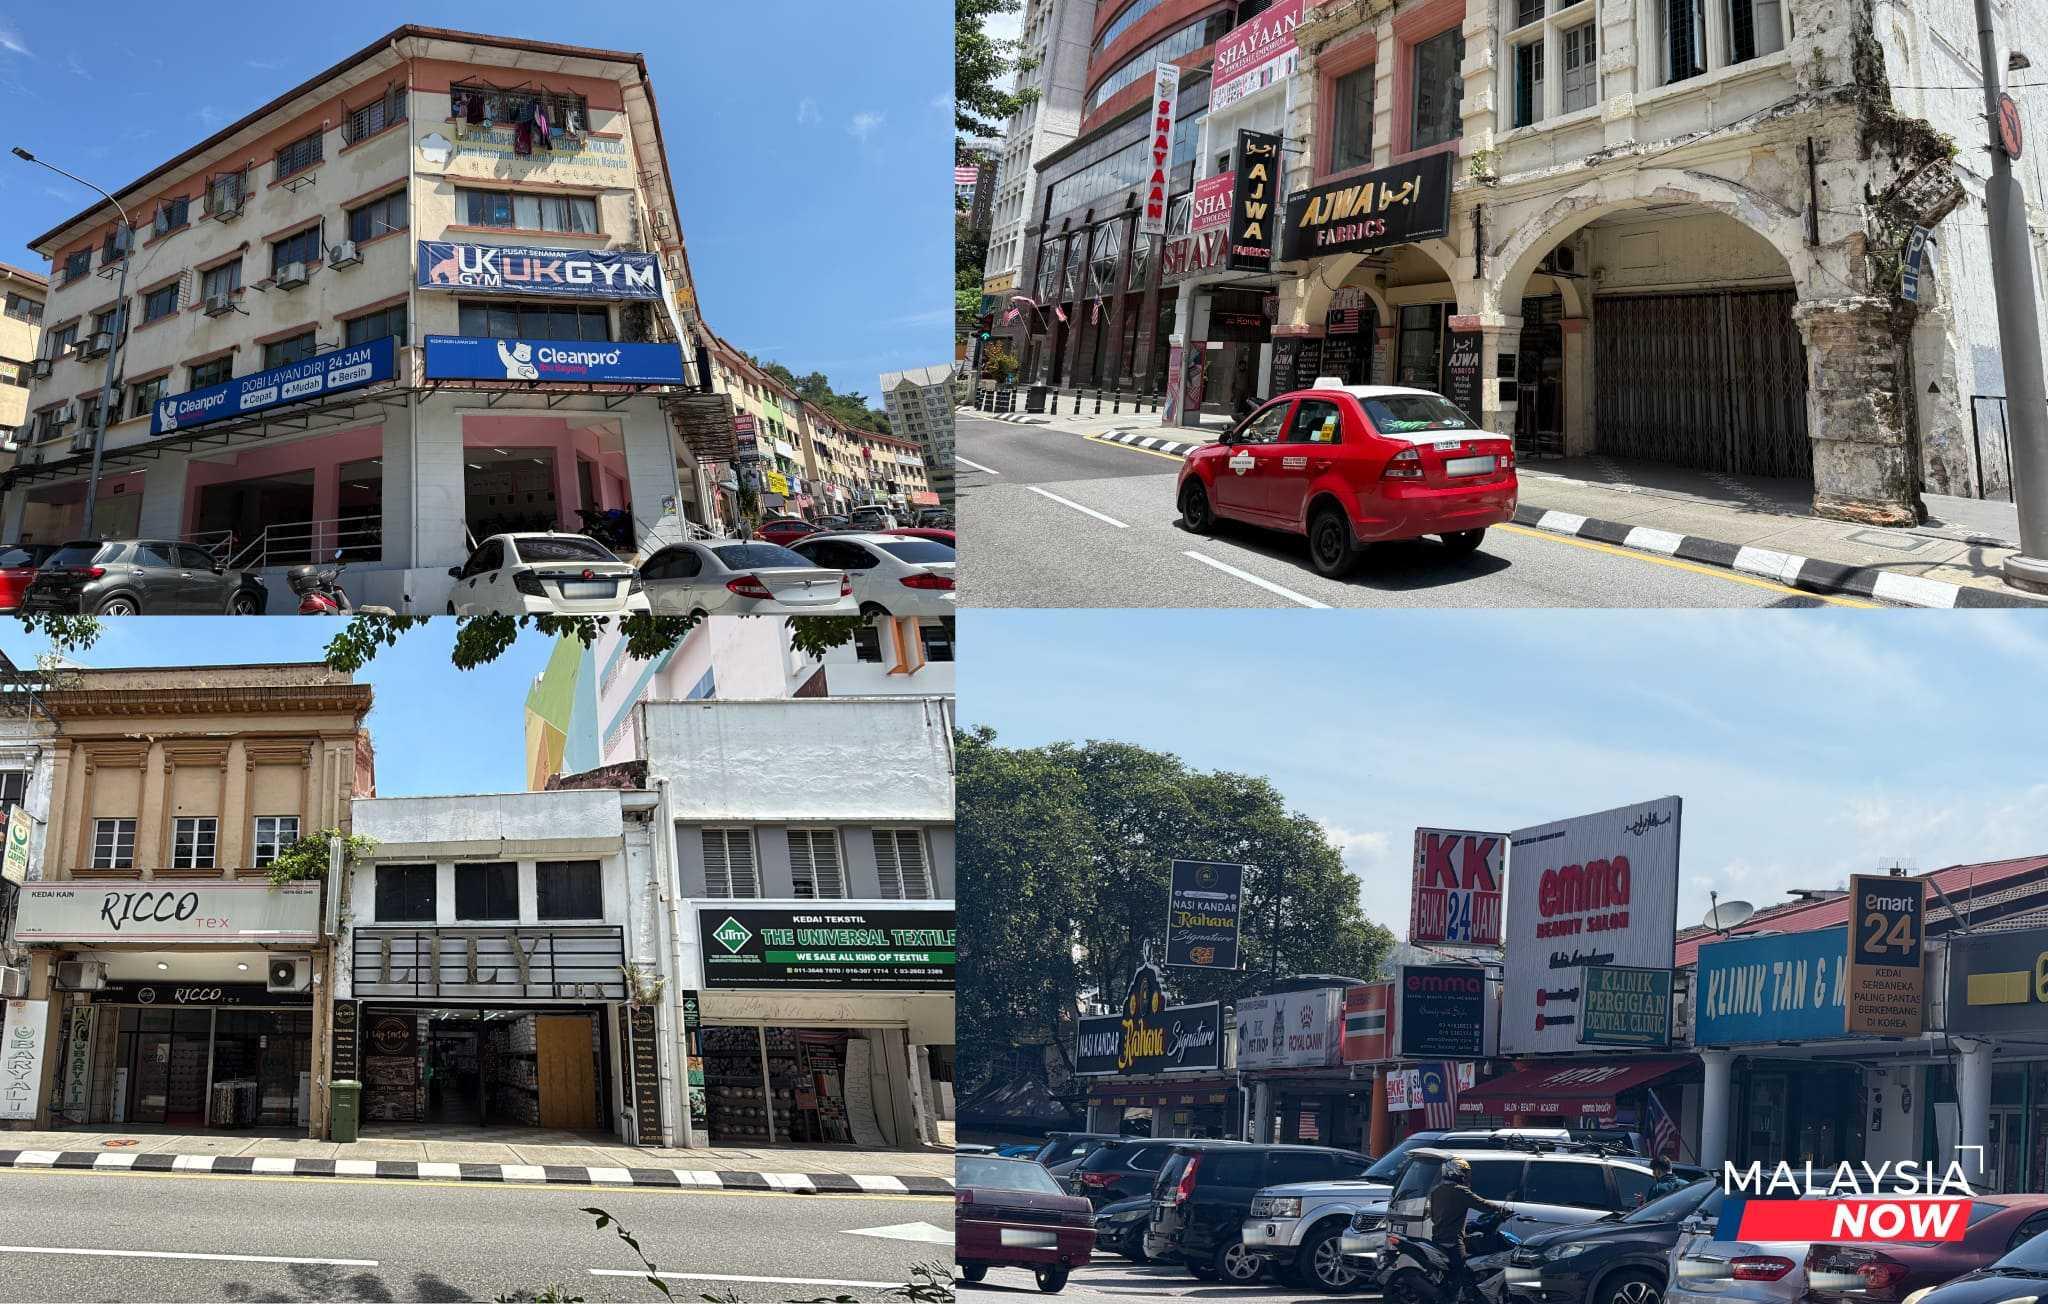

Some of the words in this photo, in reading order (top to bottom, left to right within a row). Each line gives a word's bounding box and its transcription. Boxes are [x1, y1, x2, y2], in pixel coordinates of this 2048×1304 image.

[1218, 8, 1298, 70] SHAYAAN
[1147, 100, 1170, 219] SHAYAAN
[1194, 190, 1234, 218] SHAY
[1243, 163, 1268, 240] AJWA
[1298, 182, 1374, 228] AJWA
[1202, 210, 1230, 224] WHOLESAL
[1316, 218, 1386, 247] FABRICS
[458, 246, 499, 274] UK
[502, 248, 528, 256] PUSAT
[529, 249, 567, 258] SENAMAN
[1232, 245, 1271, 258] FABRICS
[459, 273, 500, 287] GYM
[538, 347, 618, 367] Cleanpro
[1448, 352, 1479, 367] AJWA
[242, 376, 266, 392] DOBI
[268, 367, 301, 386] LAYAN
[303, 360, 325, 377] DIRI
[329, 357, 342, 370] 24
[345, 349, 371, 366] JAM
[338, 368, 367, 382] Bersih
[291, 379, 320, 393] Mudah
[179, 393, 225, 414] Cleanpro
[1425, 833, 1499, 891] KK
[32, 890, 55, 898] KEDAI
[56, 890, 75, 898] KAIN
[1538, 855, 1631, 918] emma
[100, 891, 199, 931] RICCO
[1173, 900, 1195, 910] NASI
[1197, 901, 1237, 913] KANDAR
[1865, 893, 1915, 913] emart
[793, 915, 823, 924] KEDAI
[824, 915, 866, 924] TEKSTIL
[1420, 893, 1446, 937] BUKA
[1447, 891, 1472, 941] 24
[1473, 896, 1500, 940] JAM
[1536, 918, 1582, 939] BEAUTY
[1586, 911, 1630, 933] SALON
[760, 928, 795, 946] THE
[797, 928, 890, 947] UNIVERSAL
[1863, 912, 1917, 956] 24
[375, 935, 545, 985] LILY
[796, 952, 812, 961] WE
[814, 952, 837, 961] SALE
[838, 952, 855, 961] ALL
[856, 953, 877, 961] KIND
[878, 953, 892, 962] OF
[894, 953, 930, 962] TEXTILE
[1600, 970, 1654, 993] KLINIK
[1875, 967, 1902, 978] KEDAI
[1407, 975, 1481, 993] emma
[1706, 964, 1767, 1021] KLINIK
[1772, 959, 1808, 1012] TAN
[1814, 957, 1826, 1009] &
[1862, 980, 1914, 991] SERBANEKA
[174, 988, 222, 1004] RICCO
[1587, 990, 1666, 1015] PERGIGIAN
[1854, 992, 1887, 1002] PALING
[1887, 994, 1921, 1005] PANTAS
[1858, 1004, 1918, 1016] BERKEMBANG
[1585, 1011, 1628, 1032] DENTAL
[1630, 1015, 1665, 1034] CLINIC
[1866, 1017, 1876, 1027] DI
[1877, 1018, 1907, 1029] KOREA
[1094, 1031, 1120, 1056] KANDAR
[1166, 1020, 1215, 1064] Signature
